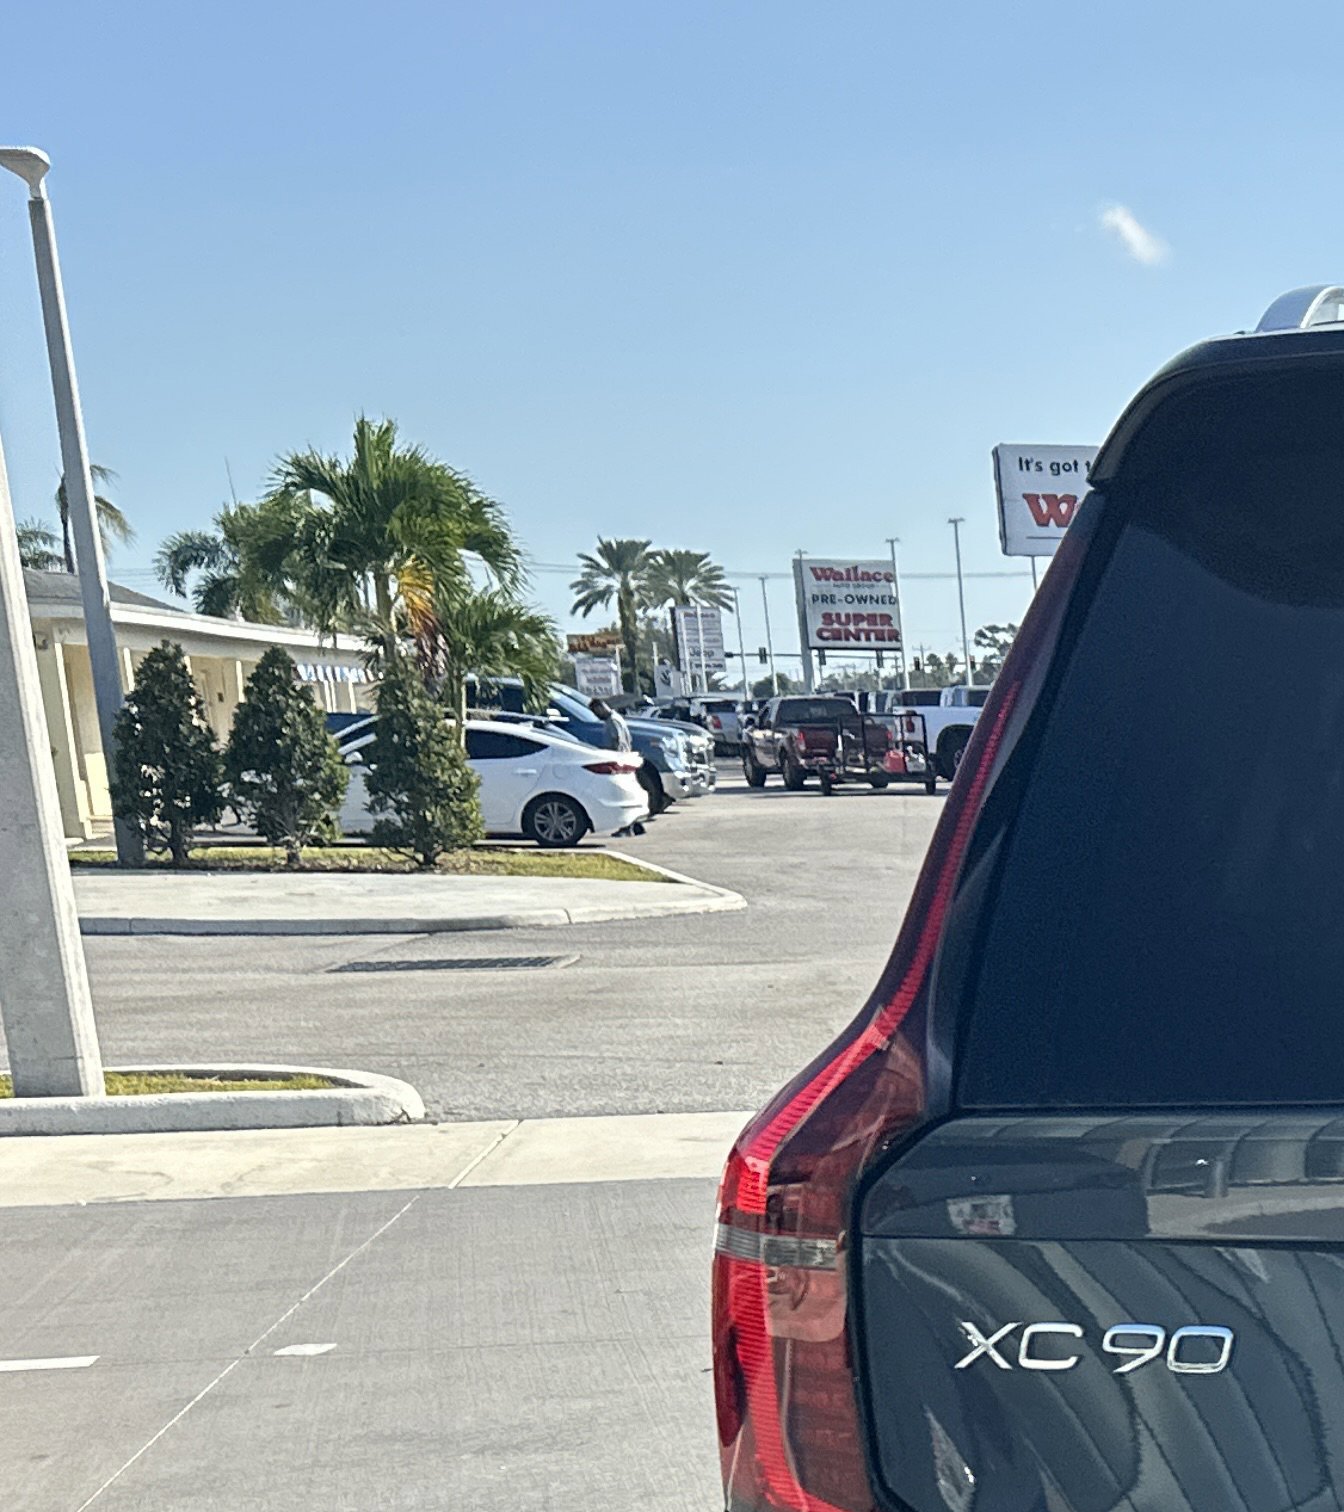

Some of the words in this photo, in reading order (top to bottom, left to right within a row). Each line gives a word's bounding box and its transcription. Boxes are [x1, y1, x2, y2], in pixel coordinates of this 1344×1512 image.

[1018, 456, 1043, 472] It's
[1050, 459, 1079, 476] got
[810, 565, 894, 583] Wallace
[812, 593, 897, 605] PRE-OWNED
[821, 612, 893, 627] SUPER
[815, 627, 901, 643] CENTER
[953, 1321, 1235, 1374] XC90
